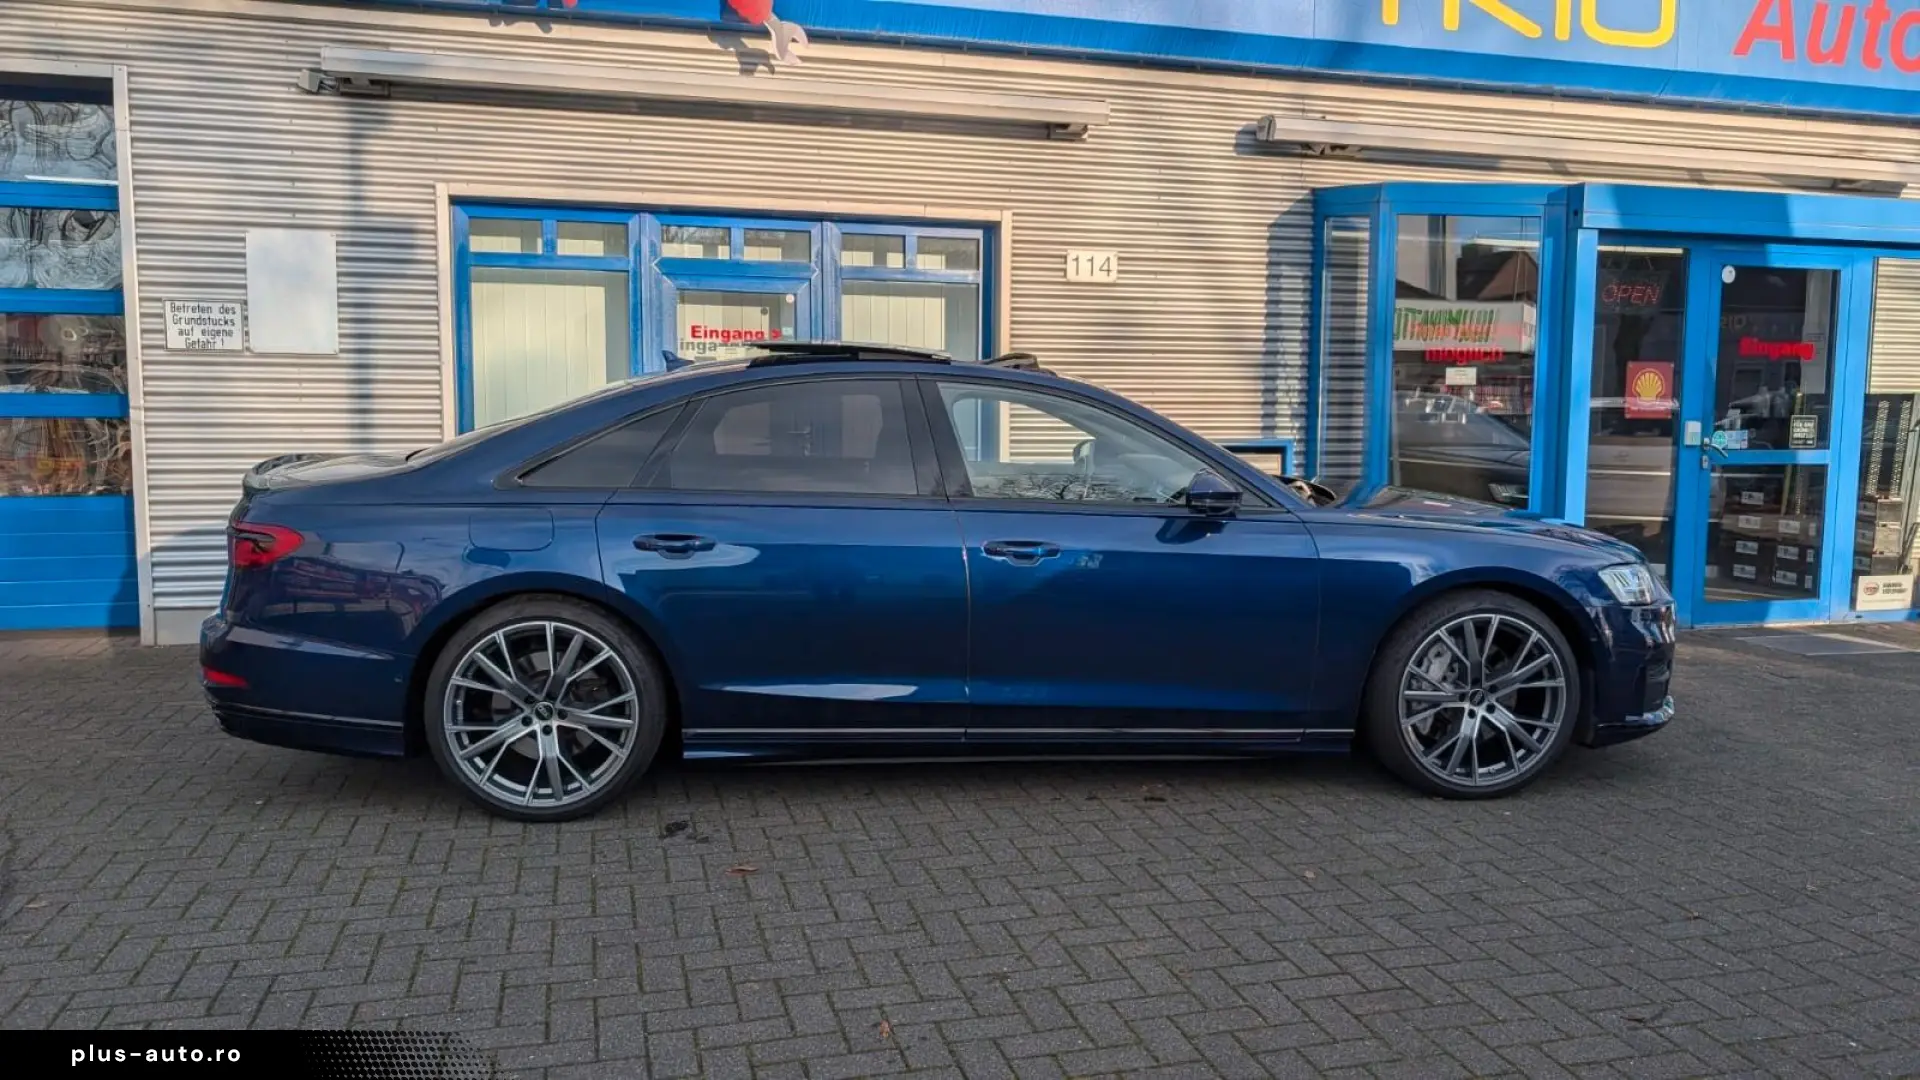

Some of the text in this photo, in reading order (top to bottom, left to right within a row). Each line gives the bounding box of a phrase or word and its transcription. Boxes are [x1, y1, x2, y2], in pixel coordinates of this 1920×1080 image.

[1071, 254, 1113, 277] 114
[1602, 284, 1660, 305] OPEN
[170, 302, 236, 315] Betreten des
[178, 326, 234, 340] auf eigene
[690, 325, 765, 343] Eingang
[185, 337, 216, 350] Gefahr
[1739, 336, 1815, 360] Eingang
